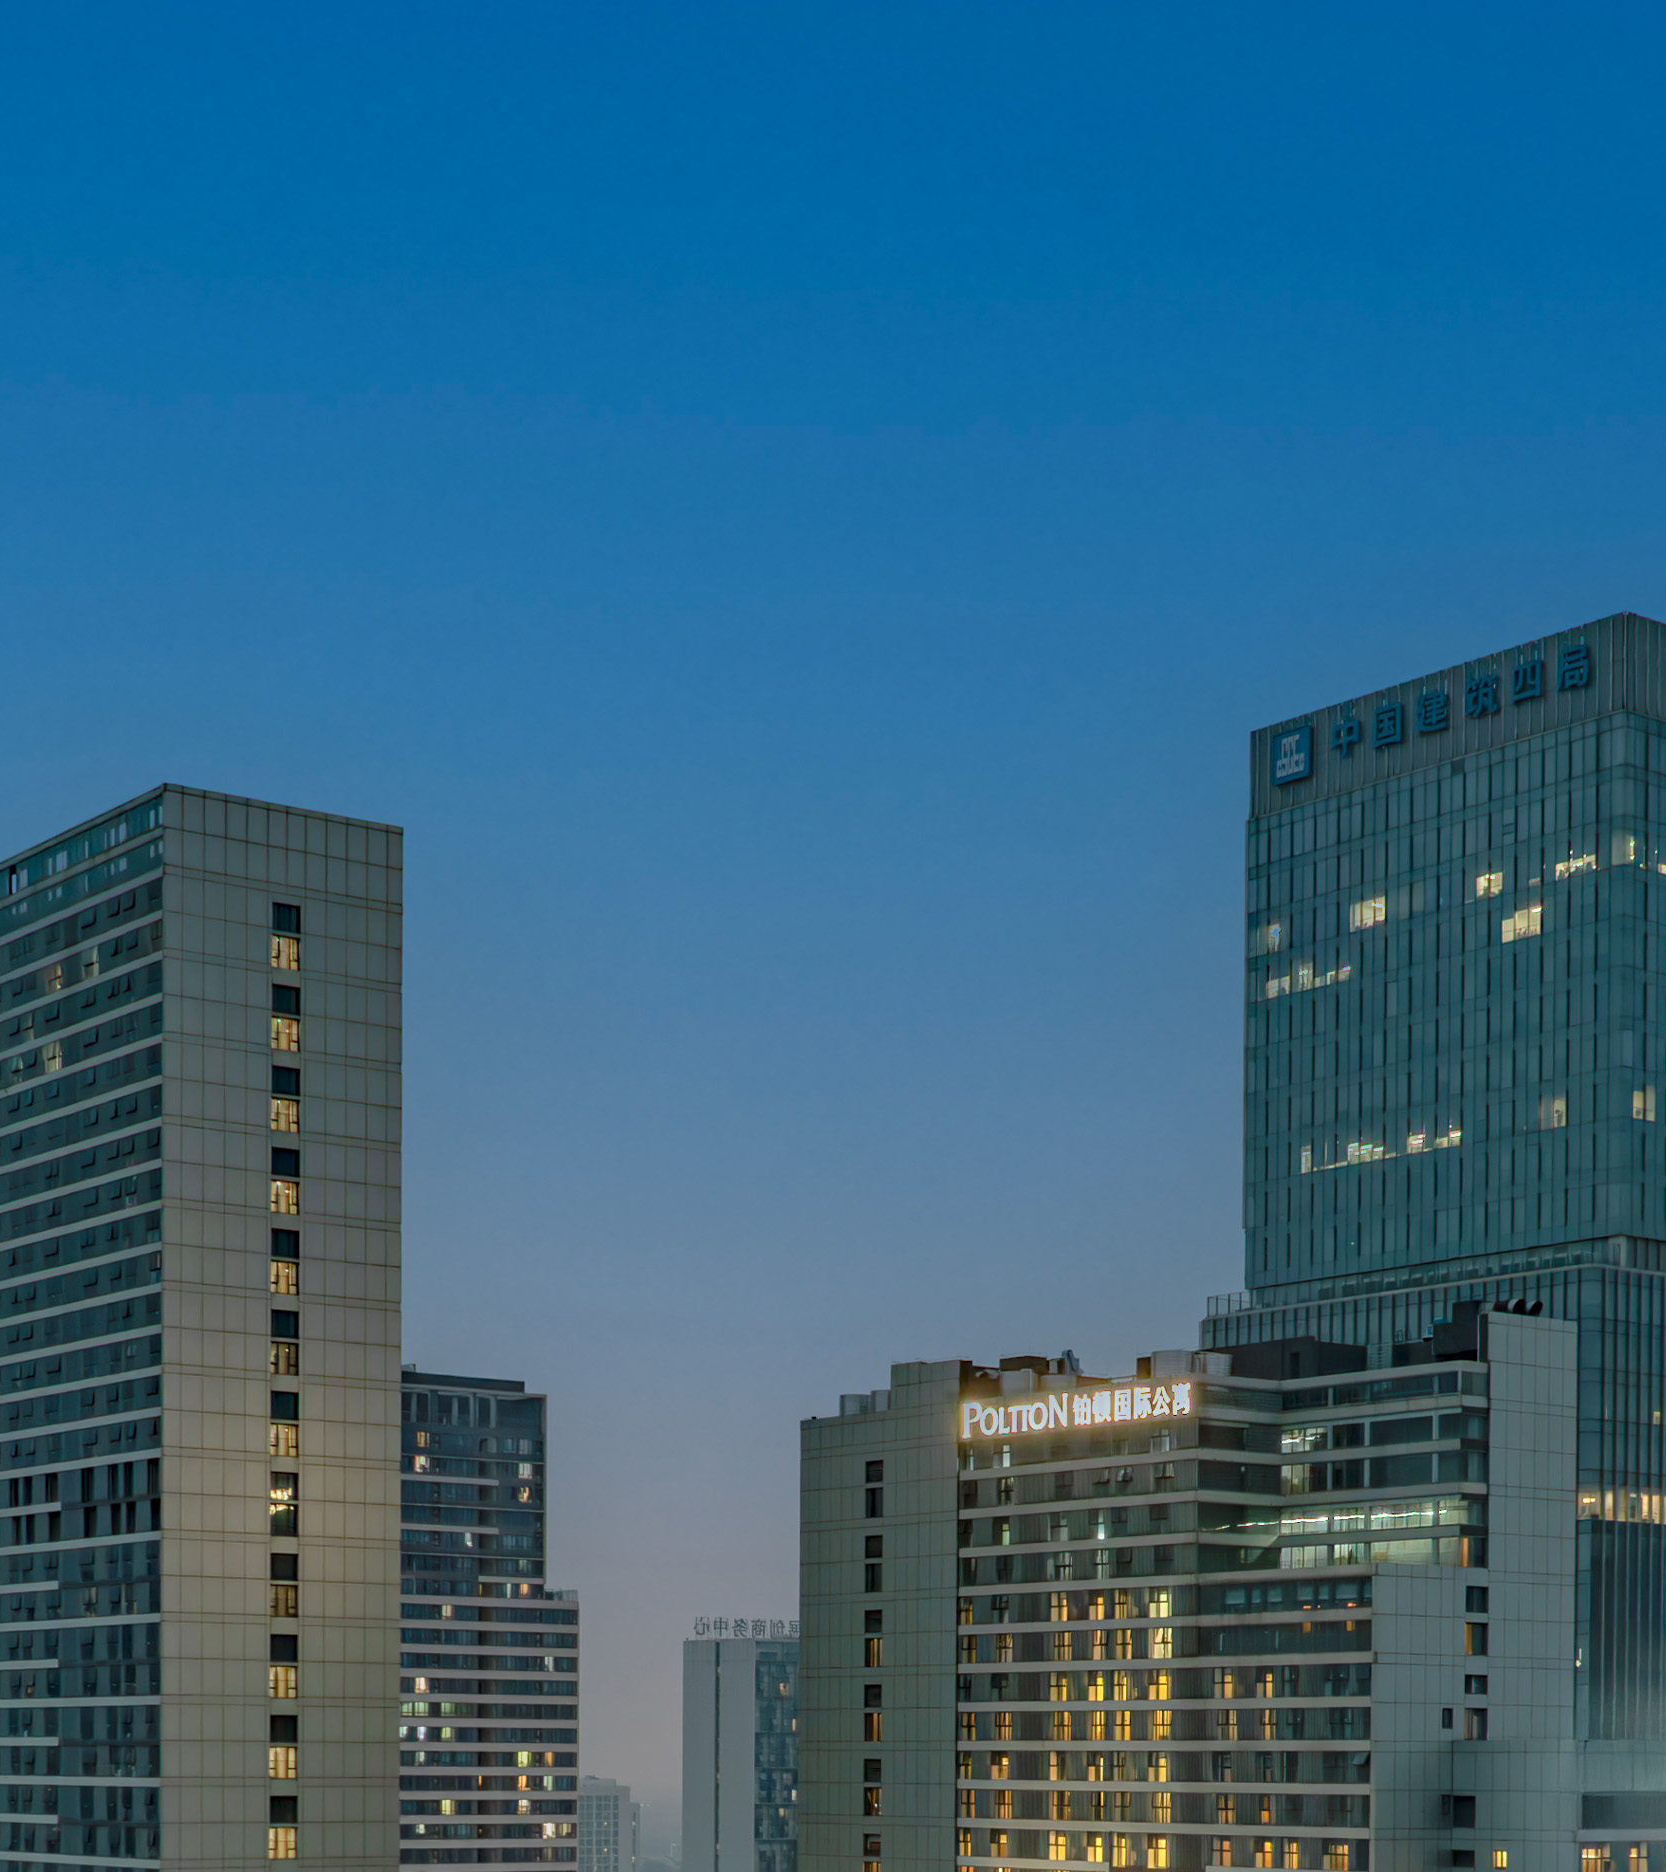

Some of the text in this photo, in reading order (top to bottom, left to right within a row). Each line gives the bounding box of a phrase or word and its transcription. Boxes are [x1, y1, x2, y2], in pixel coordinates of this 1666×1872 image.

[1333, 643, 1589, 758] 中国建筑四局
[1072, 1382, 1191, 1426] 铂顿国际公寓
